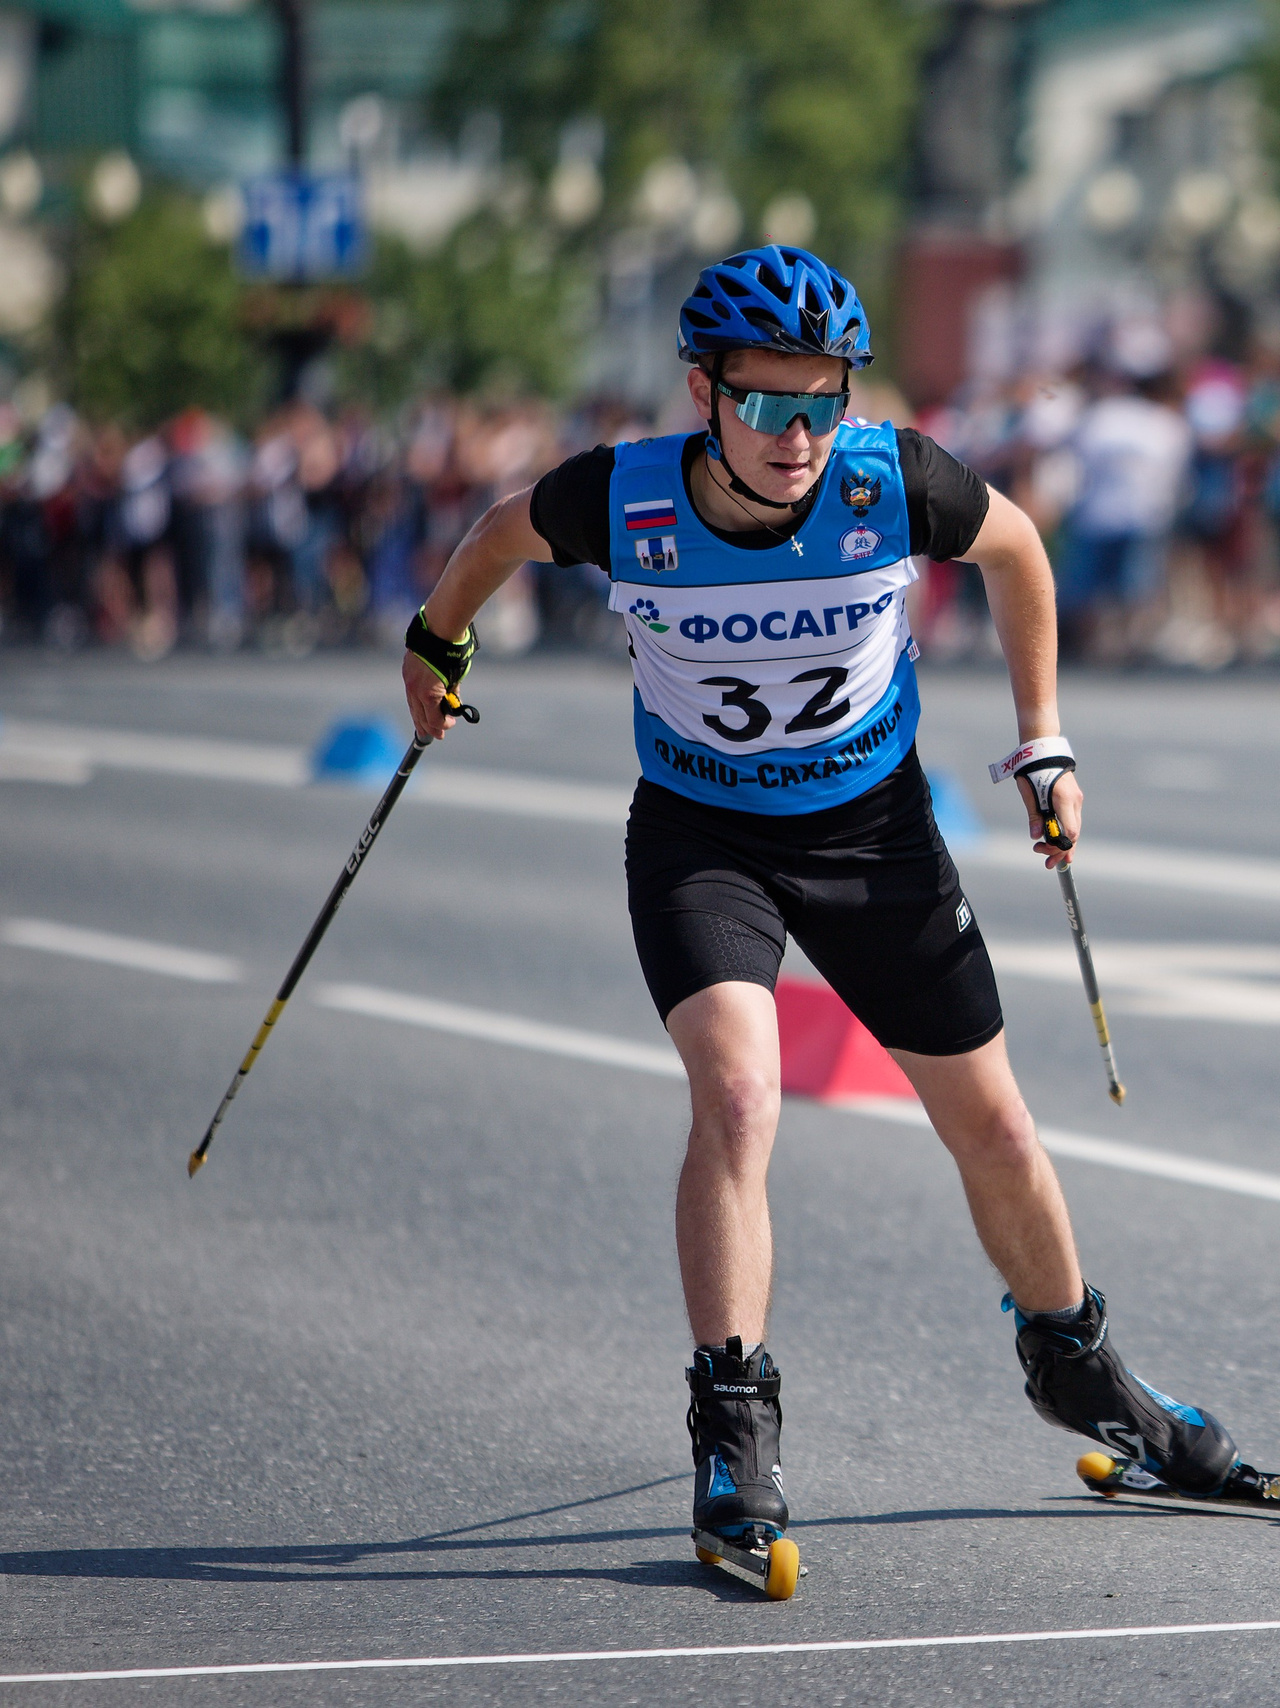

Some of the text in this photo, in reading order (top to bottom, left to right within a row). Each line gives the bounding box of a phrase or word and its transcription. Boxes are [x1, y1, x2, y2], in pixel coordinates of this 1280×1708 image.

[679, 591, 895, 644] ФОСАГРО
[697, 667, 851, 742] 32
[345, 821, 381, 875] EXEC
